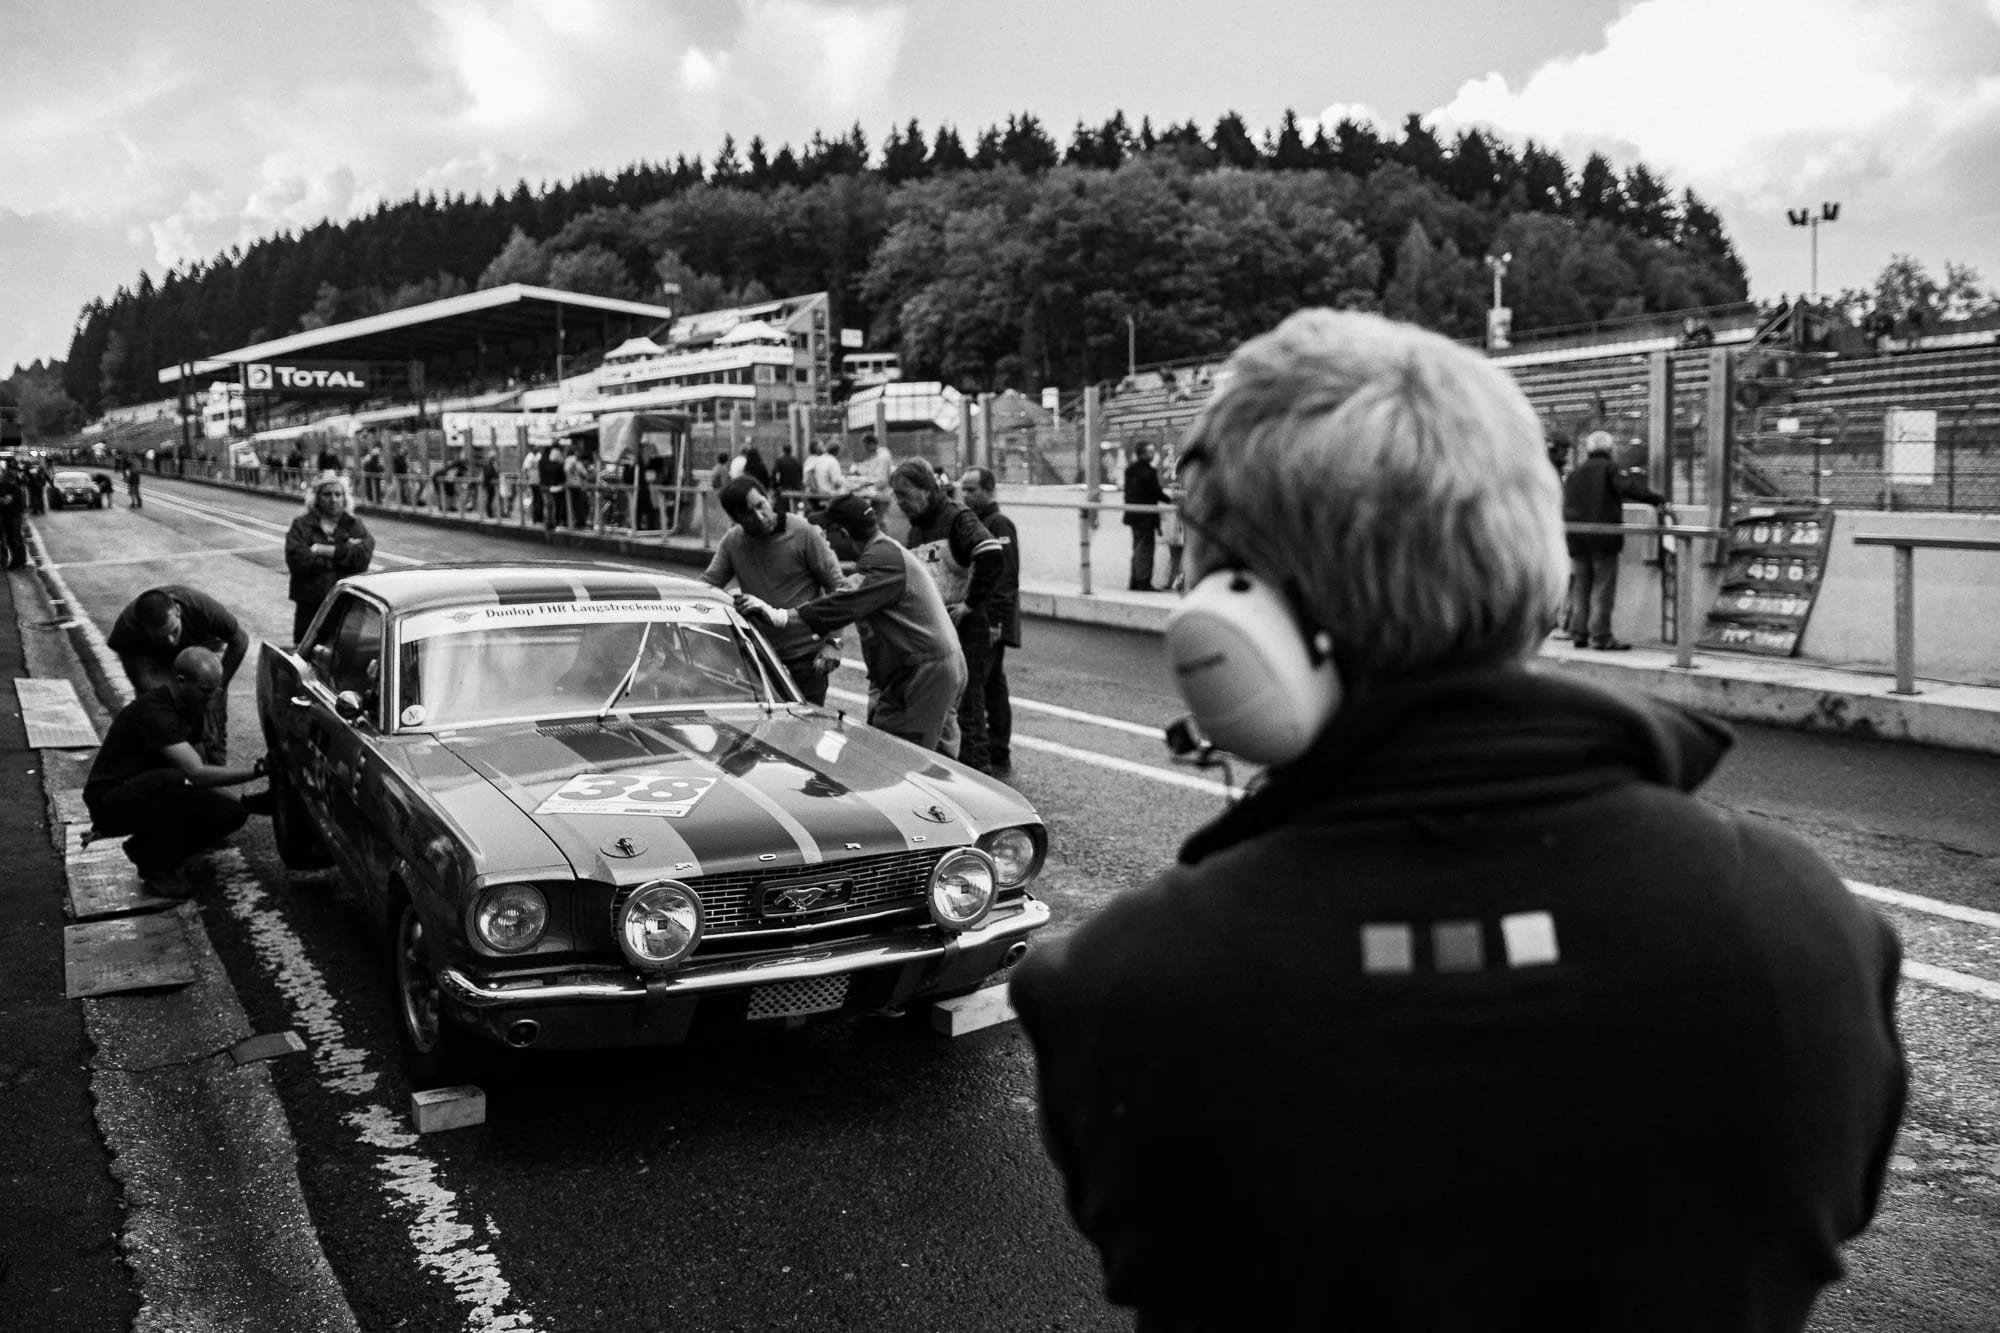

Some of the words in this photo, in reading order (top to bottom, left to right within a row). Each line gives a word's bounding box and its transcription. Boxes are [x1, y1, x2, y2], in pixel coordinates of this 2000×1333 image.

[275, 366, 365, 388] TOTAL
[486, 607, 534, 617] Dunlop
[539, 604, 566, 614] FHR
[571, 602, 681, 613] Langstreckencup
[558, 775, 712, 802] 38
